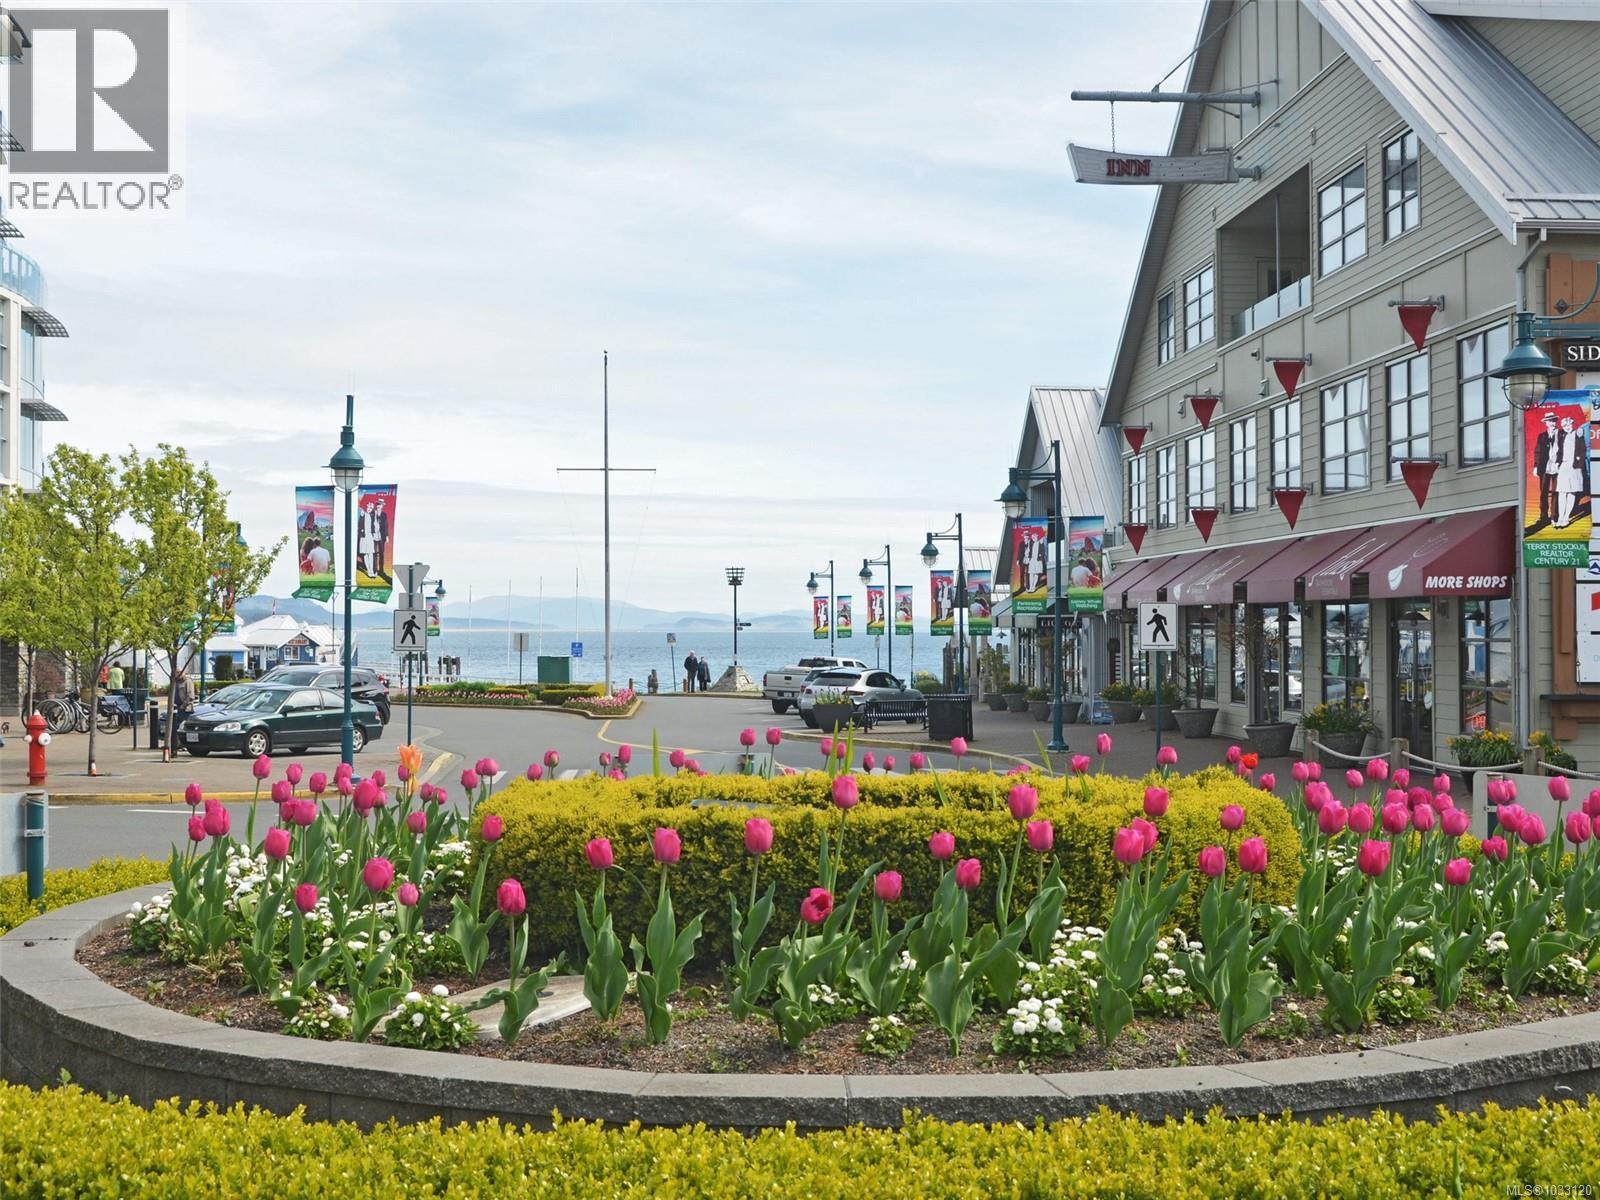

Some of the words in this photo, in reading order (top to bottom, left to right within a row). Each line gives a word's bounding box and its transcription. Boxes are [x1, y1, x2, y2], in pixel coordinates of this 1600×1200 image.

[1106, 158, 1151, 177] INN
[1525, 543, 1550, 551] TERRY
[1540, 550, 1574, 558] REALTOR
[1534, 557, 1569, 565] CENTURY
[1571, 558, 1580, 566] 21
[1425, 576, 1463, 588] MORE
[1466, 576, 1507, 588] SHOPS
